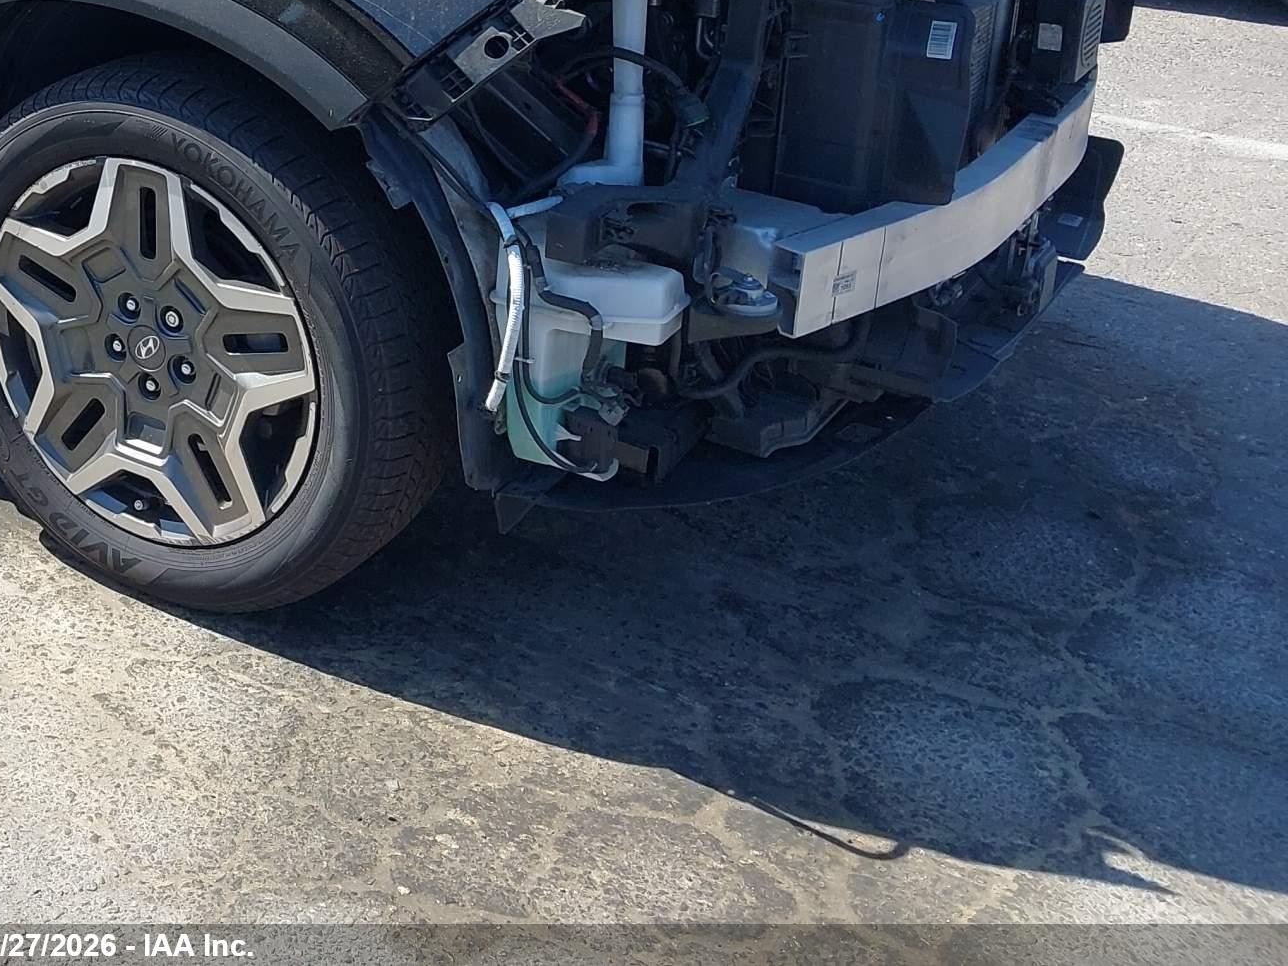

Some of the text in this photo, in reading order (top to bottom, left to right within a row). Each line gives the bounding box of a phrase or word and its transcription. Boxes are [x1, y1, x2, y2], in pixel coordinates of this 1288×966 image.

[169, 132, 300, 260] YOKOHAMA
[10, 469, 143, 573] AVID GT
